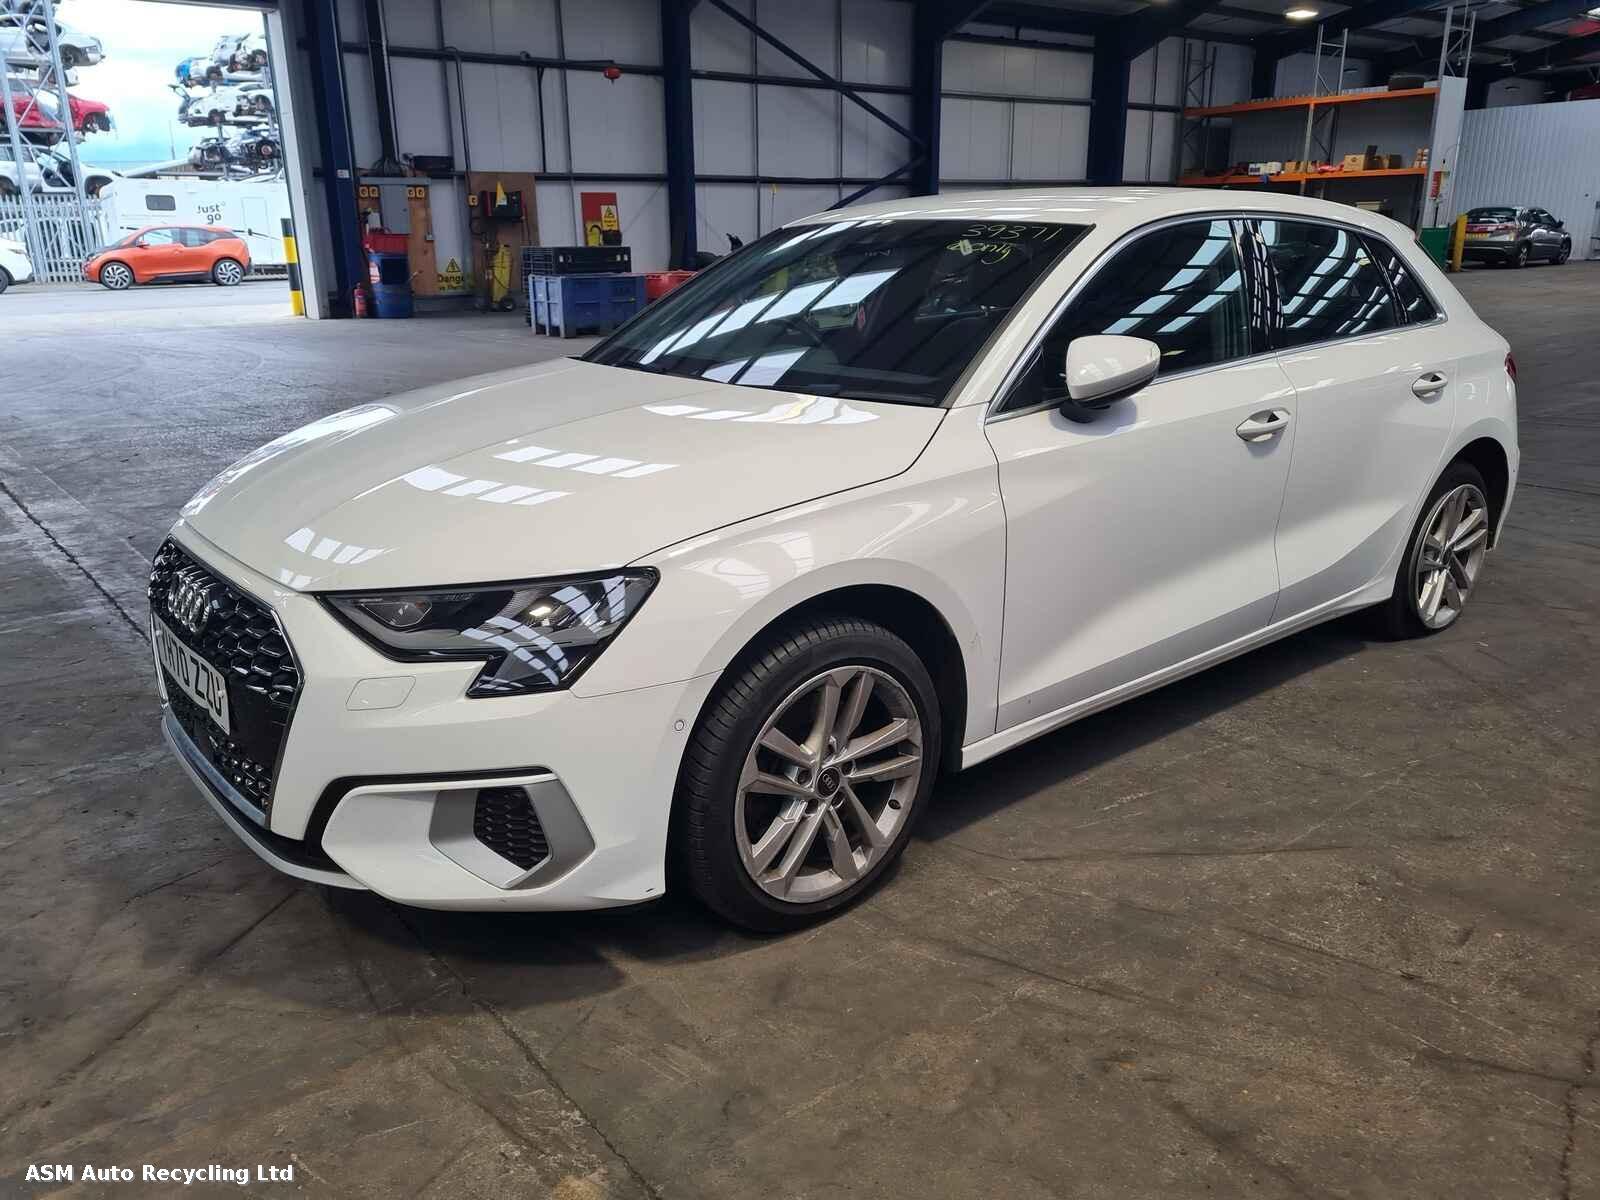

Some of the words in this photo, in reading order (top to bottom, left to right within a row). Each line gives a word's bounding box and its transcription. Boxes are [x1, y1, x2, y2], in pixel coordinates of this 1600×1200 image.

[196, 204, 220, 214] Just
[207, 213, 222, 225] go
[436, 273, 467, 285] Dange
